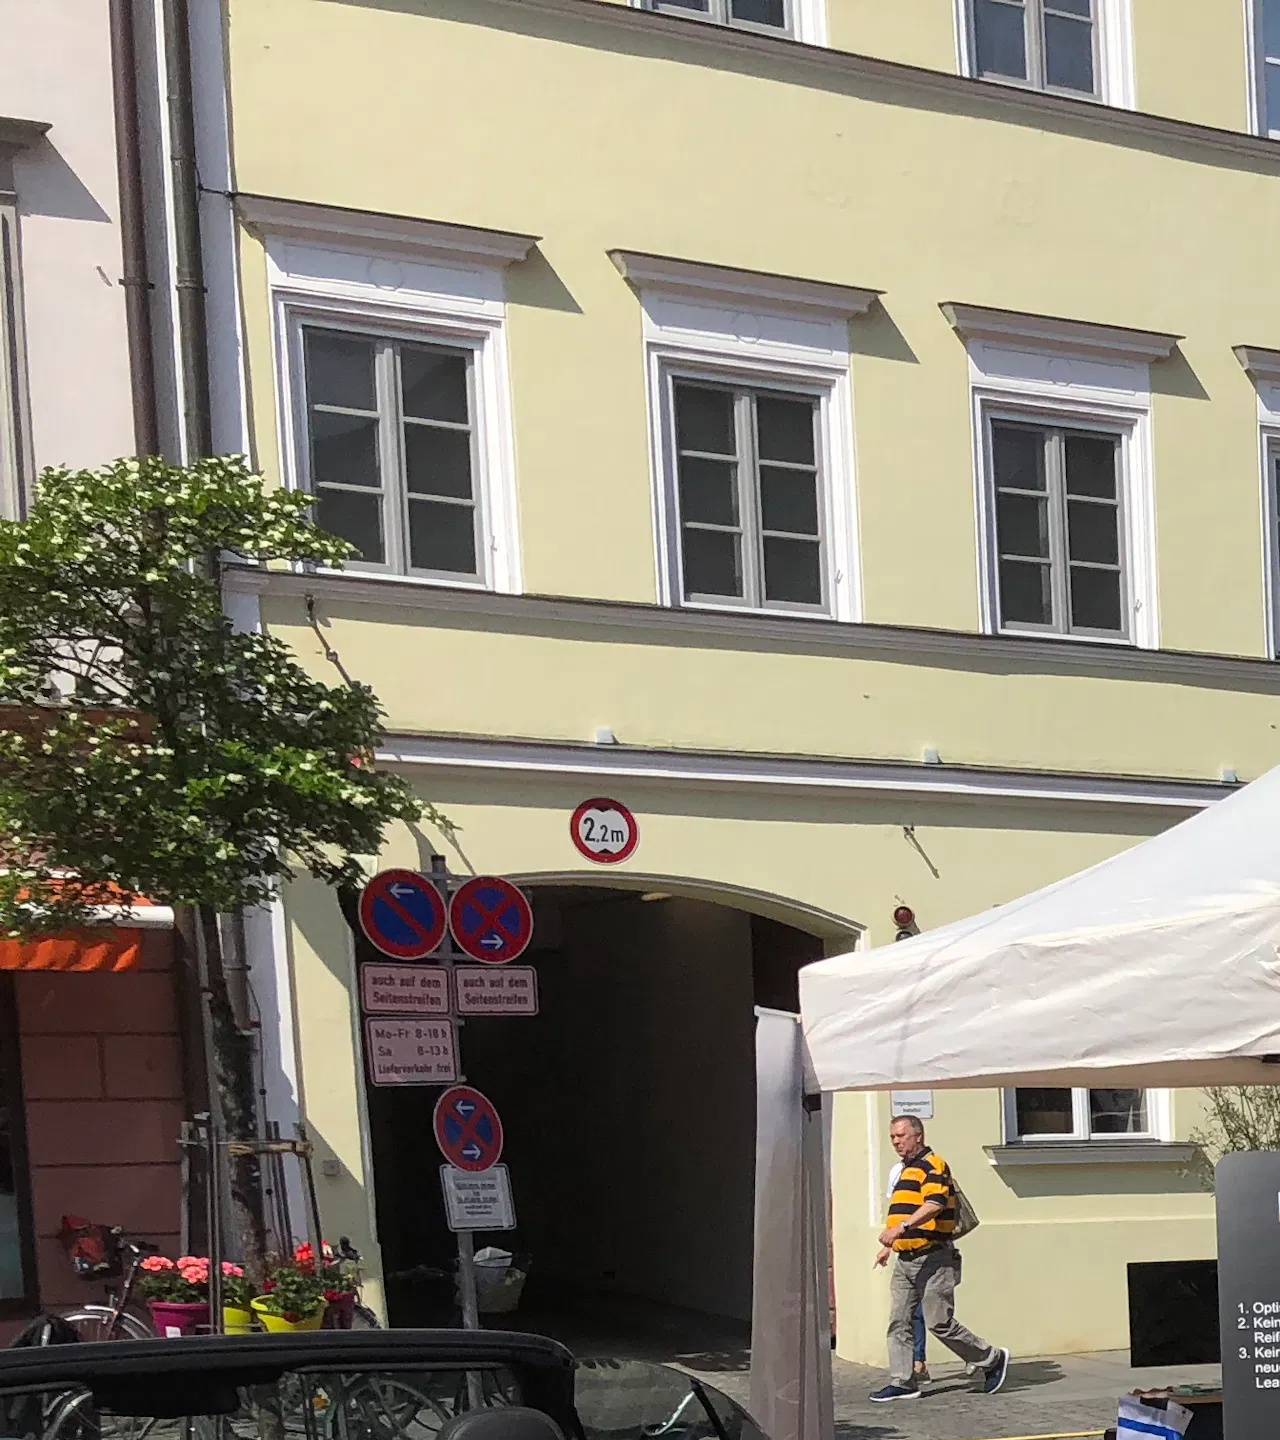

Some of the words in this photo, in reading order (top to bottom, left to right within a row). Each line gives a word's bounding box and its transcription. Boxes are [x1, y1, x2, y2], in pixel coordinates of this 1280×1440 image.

[372, 974, 396, 986] auch
[399, 976, 415, 987] auf
[420, 977, 441, 989] dem
[463, 976, 485, 988] auch
[489, 977, 504, 989] auf
[508, 977, 528, 989] dem
[373, 991, 441, 1006] Seitenstreifen
[464, 993, 528, 1005] Seitenstreifen
[375, 1028, 410, 1039] Mo-Fr
[378, 1046, 393, 1057] Sa
[378, 1064, 433, 1075] Lieferverkehr
[1237, 1303, 1249, 1315] 1.
[1237, 1318, 1250, 1330] 2.
[1238, 1347, 1250, 1359] 3.
